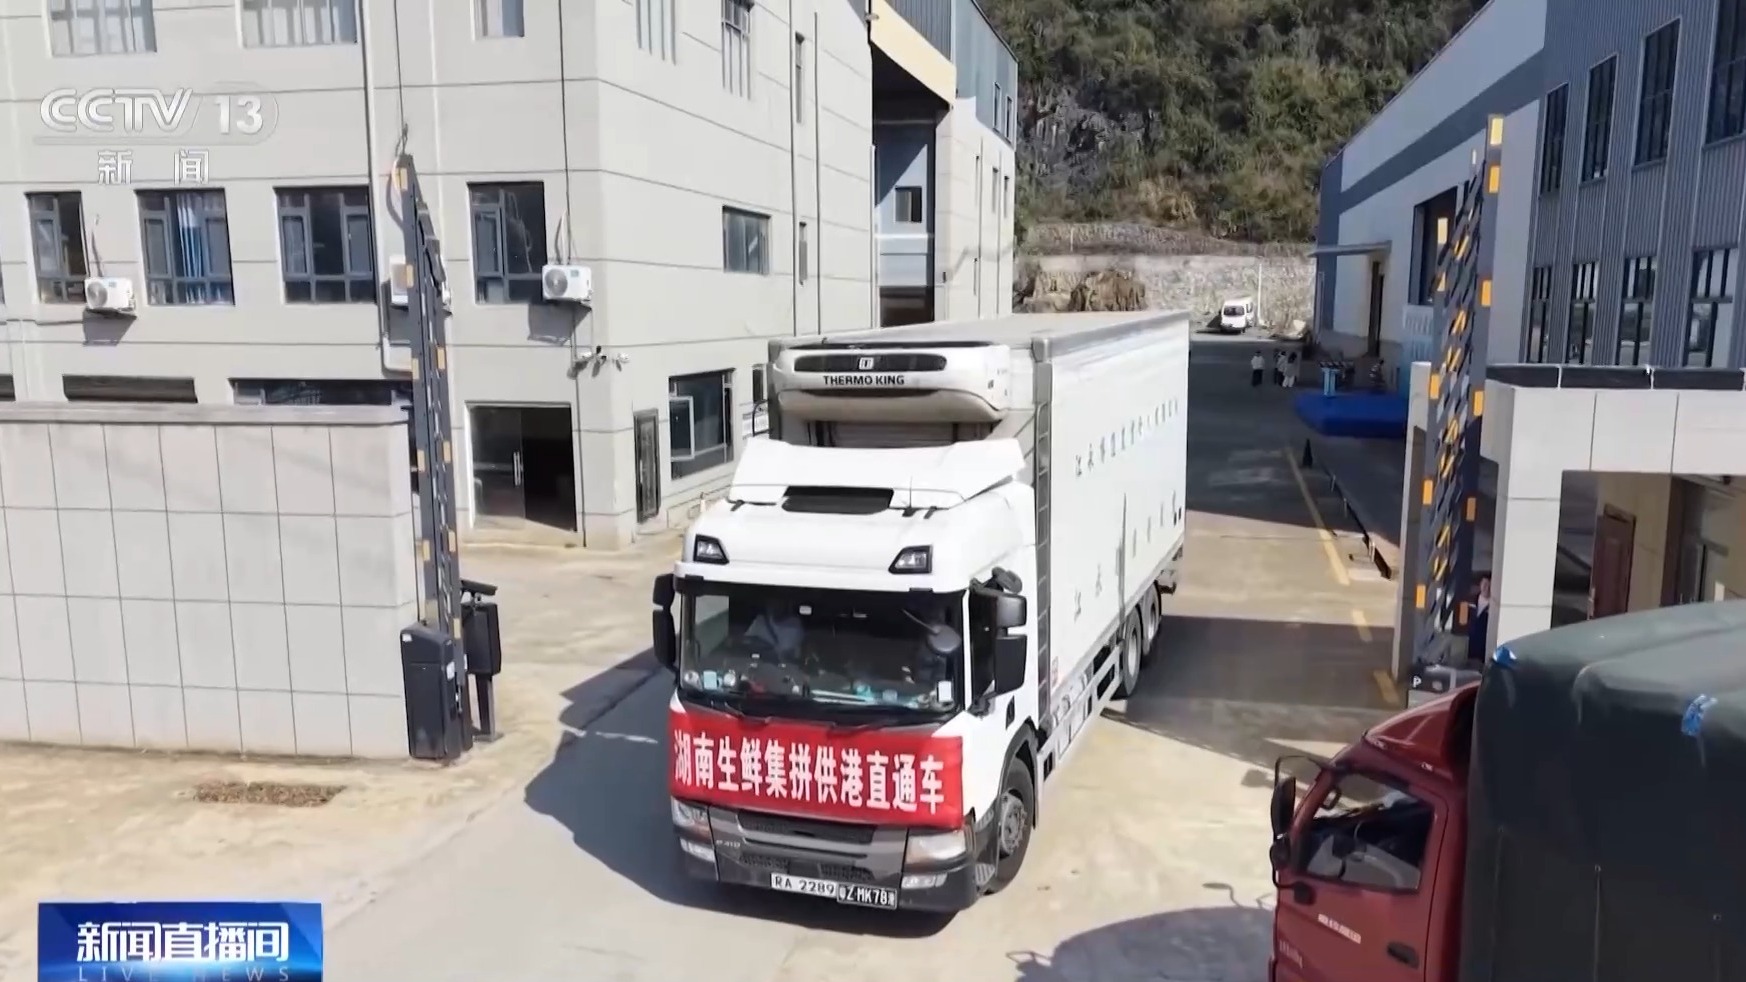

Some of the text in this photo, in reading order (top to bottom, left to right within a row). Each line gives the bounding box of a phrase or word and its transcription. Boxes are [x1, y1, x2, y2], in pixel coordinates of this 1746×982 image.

[823, 375, 905, 385] THERMO KING
[674, 729, 945, 815] 湖南生鲜集拼供港直通车
[775, 876, 835, 895] RA 2289
